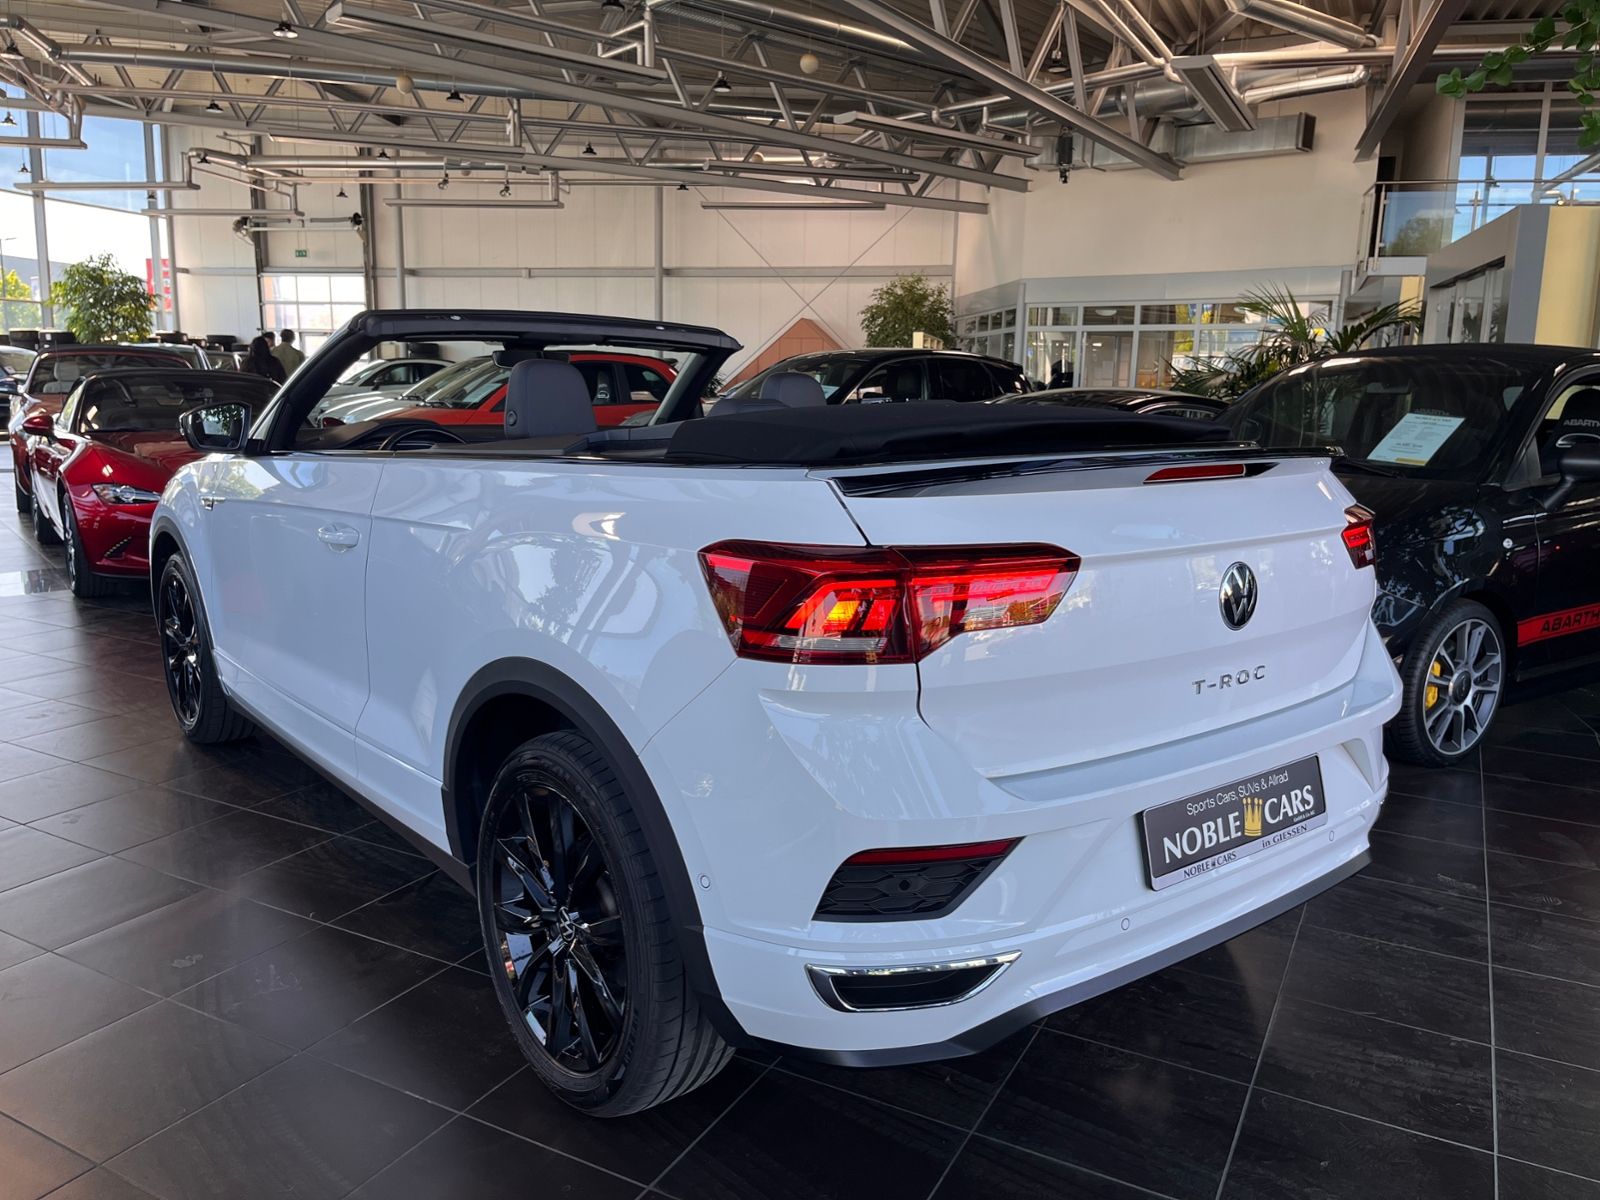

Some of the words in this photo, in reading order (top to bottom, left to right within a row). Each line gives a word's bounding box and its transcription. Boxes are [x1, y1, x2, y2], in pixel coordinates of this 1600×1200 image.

[1192, 665, 1266, 695] T-ROC
[1186, 797, 1216, 816] Sports
[1238, 782, 1260, 798] SUVs
[1260, 778, 1268, 790] &
[1268, 770, 1289, 788] Allrad
[1162, 811, 1241, 864] NOBLE
[1264, 785, 1314, 824] CARS
[1262, 839, 1272, 849] in
[1272, 824, 1307, 843] GIESSEN
[1183, 860, 1210, 878] NOBLE
[1216, 851, 1237, 866] CARS
